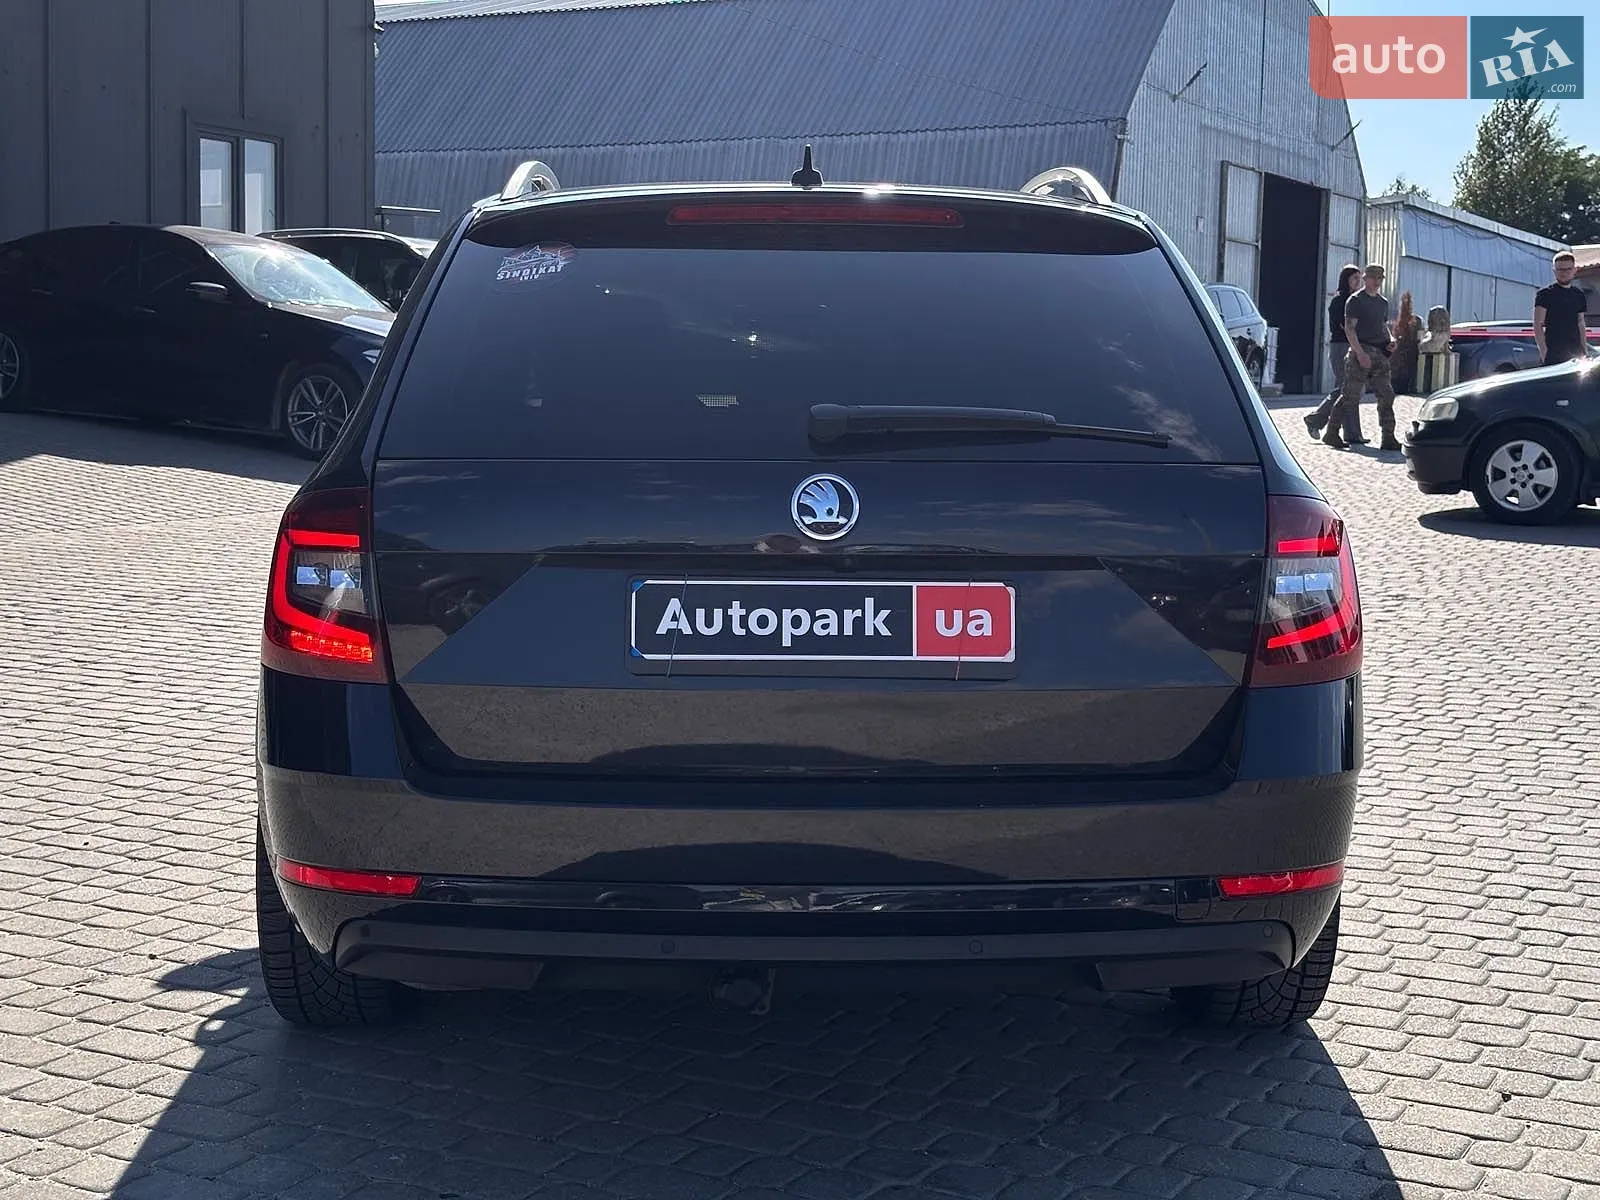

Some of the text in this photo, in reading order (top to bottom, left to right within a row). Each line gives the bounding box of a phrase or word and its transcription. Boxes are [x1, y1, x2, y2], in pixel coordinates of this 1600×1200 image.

[496, 264, 565, 280] SINDIKAT
[655, 597, 993, 647] Autopark ua
